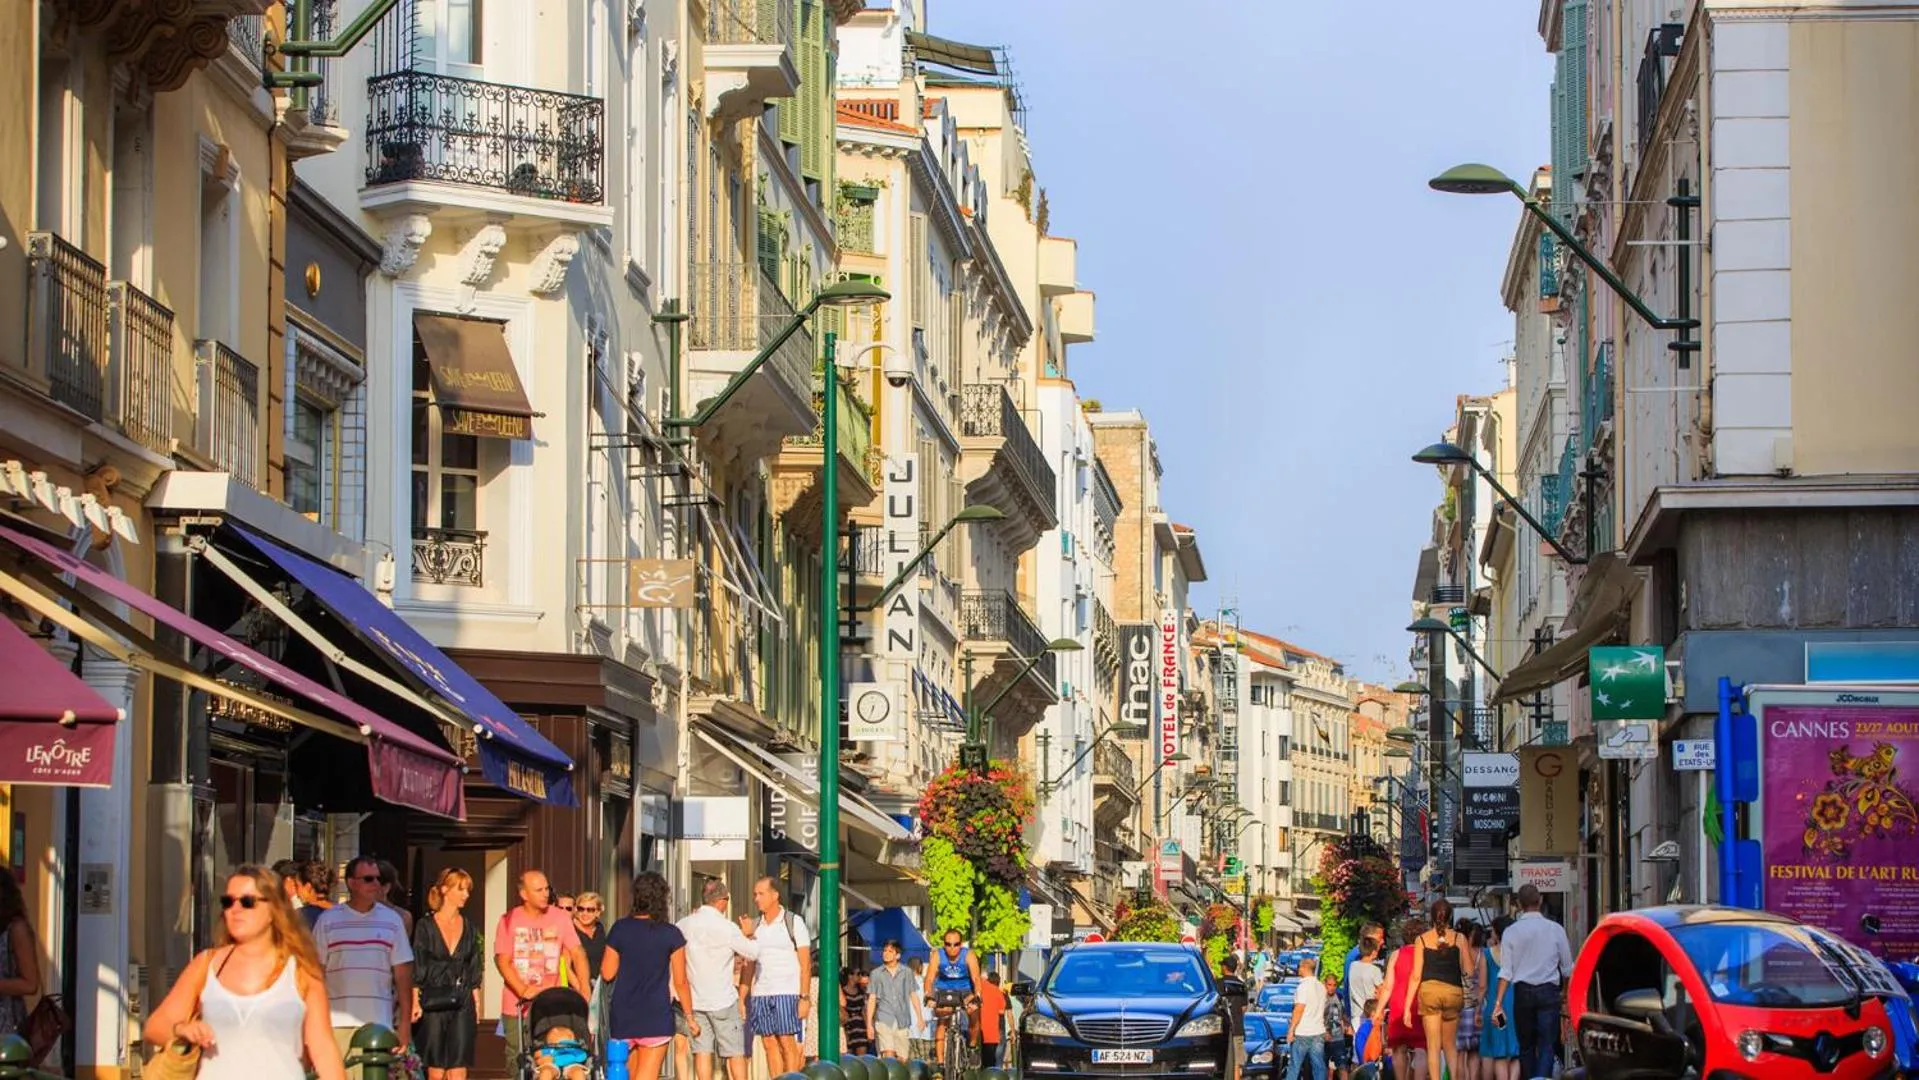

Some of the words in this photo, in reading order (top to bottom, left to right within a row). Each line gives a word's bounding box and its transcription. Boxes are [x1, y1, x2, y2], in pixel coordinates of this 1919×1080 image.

[888, 459, 914, 652] JULIAN
[1162, 623, 1176, 687] FRANCE
[1120, 634, 1150, 726] fnac
[1163, 693, 1175, 710] de
[1162, 713, 1177, 767] HOTEL
[1771, 720, 1849, 739] CANNES
[1855, 722, 1882, 733] 23/27
[26, 738, 91, 767] LENÔTRE
[1693, 743, 1710, 751] RUE
[770, 767, 786, 840] STUDO
[1520, 867, 1563, 877] FRANCE
[1770, 865, 1832, 879] FESTIVAL
[1836, 866, 1856, 879] DE
[1859, 866, 1897, 879] L'ART
[1100, 1051, 1110, 1061] AF
